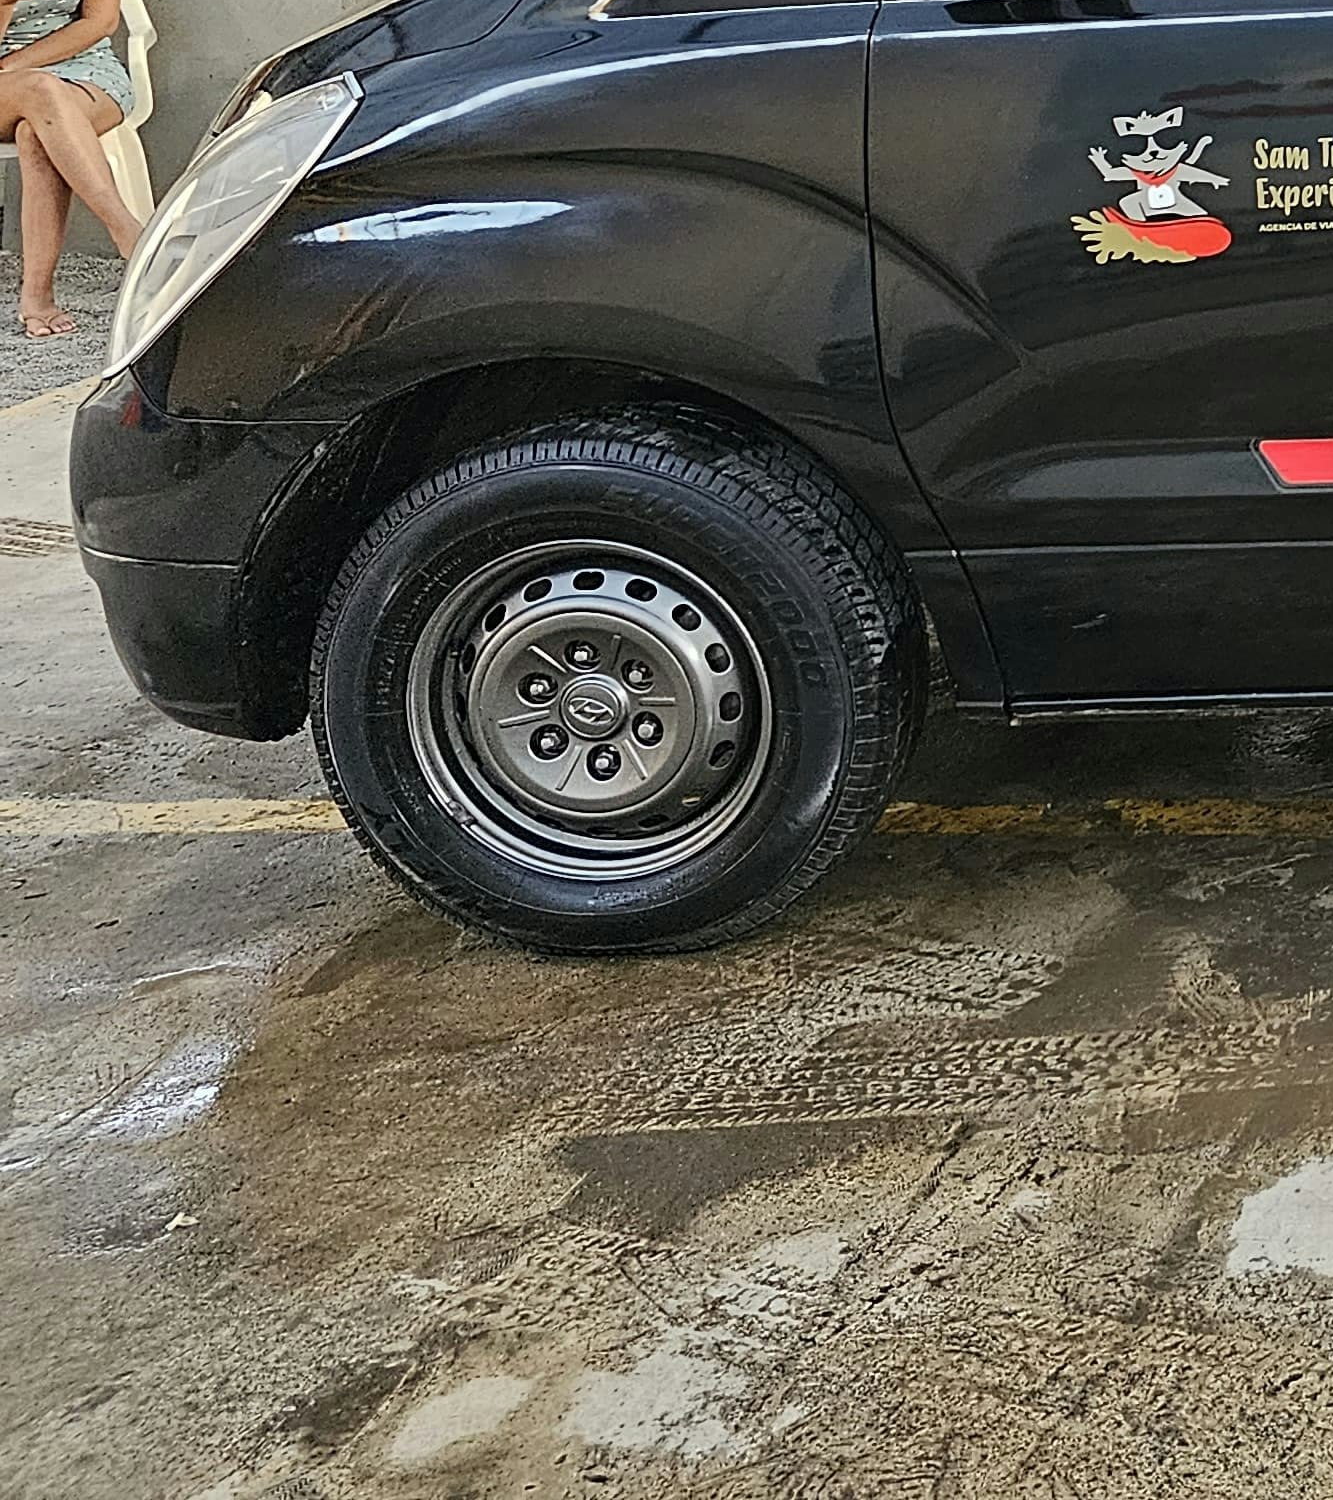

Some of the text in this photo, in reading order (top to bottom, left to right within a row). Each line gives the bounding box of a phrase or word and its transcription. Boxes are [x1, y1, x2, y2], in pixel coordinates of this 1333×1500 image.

[1253, 138, 1309, 170] Sam
[1258, 223, 1302, 232] AGENCIA
[1303, 221, 1318, 231] DE
